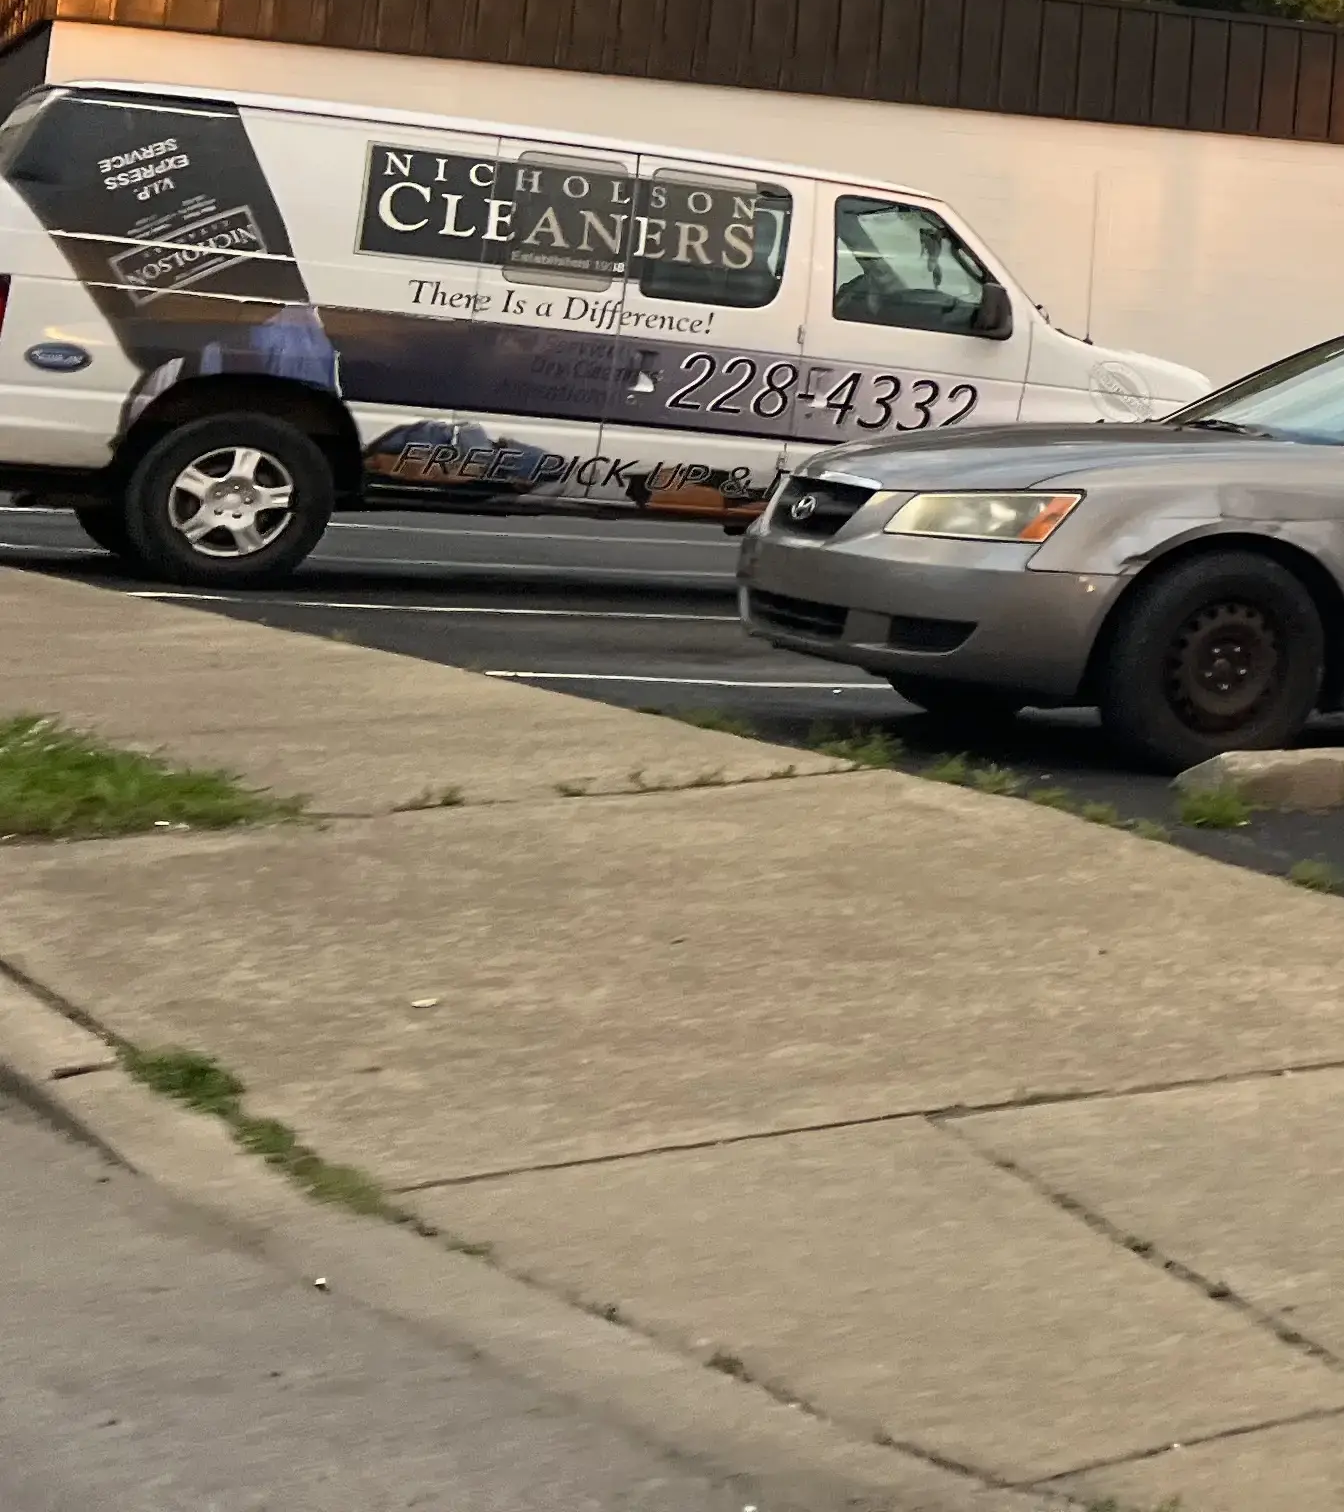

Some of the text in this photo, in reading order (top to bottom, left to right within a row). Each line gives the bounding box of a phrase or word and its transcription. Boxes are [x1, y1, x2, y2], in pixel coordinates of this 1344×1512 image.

[97, 138, 179, 173] SERVICE
[103, 154, 190, 190] EXPRESS
[382, 151, 758, 220] NICHOLSON
[378, 181, 755, 269] CLEANERS
[408, 279, 715, 335] There Is a Difference!
[665, 351, 979, 430] 228-4332
[391, 441, 525, 482] FREE
[528, 452, 641, 488] PICK
[644, 459, 711, 493] UP
[718, 465, 752, 499] &
